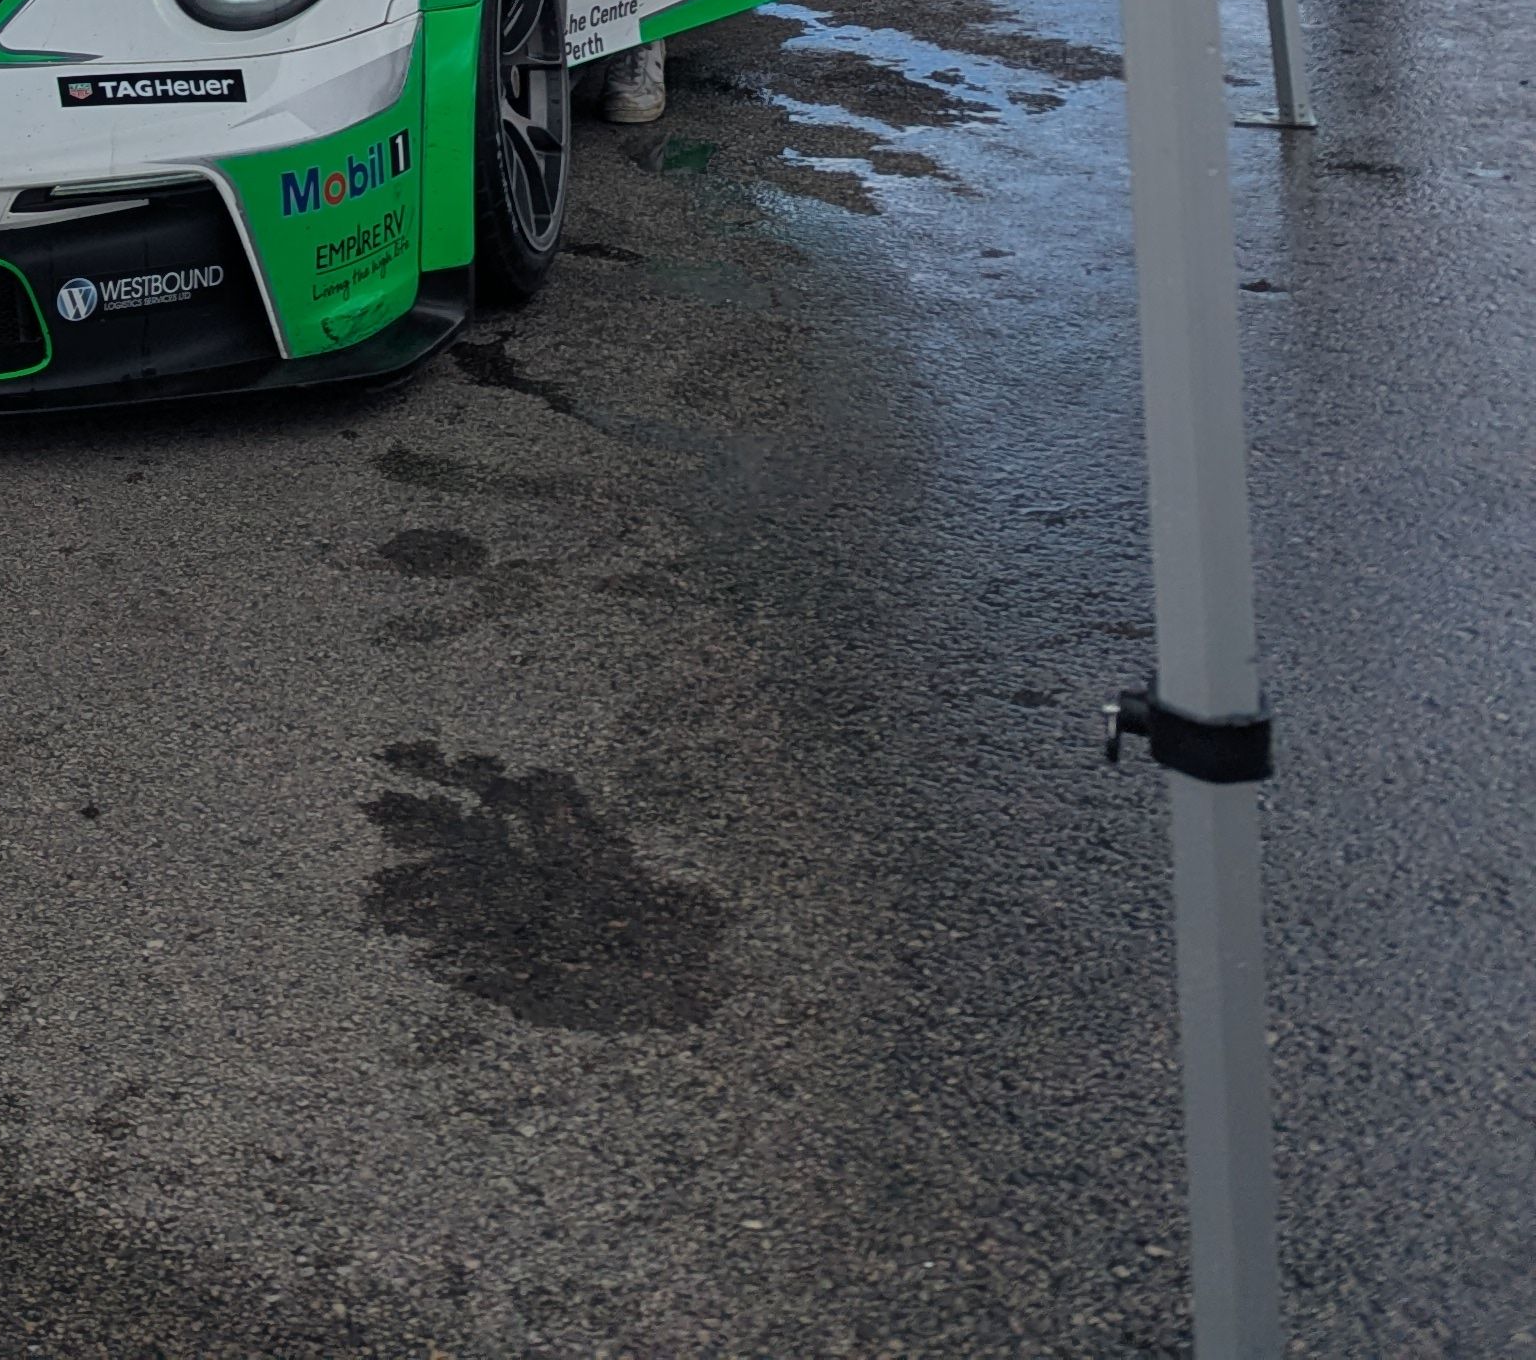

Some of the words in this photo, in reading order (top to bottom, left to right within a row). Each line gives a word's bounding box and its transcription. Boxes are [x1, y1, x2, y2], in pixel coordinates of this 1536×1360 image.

[280, 142, 385, 216] Mobil
[316, 223, 382, 270] EMPIRE
[383, 204, 406, 243] RV
[99, 265, 225, 302] WESTBOUND
[103, 298, 143, 312] LOGISTICS
[143, 294, 178, 306] SERVICES
[178, 291, 192, 301] LTD
